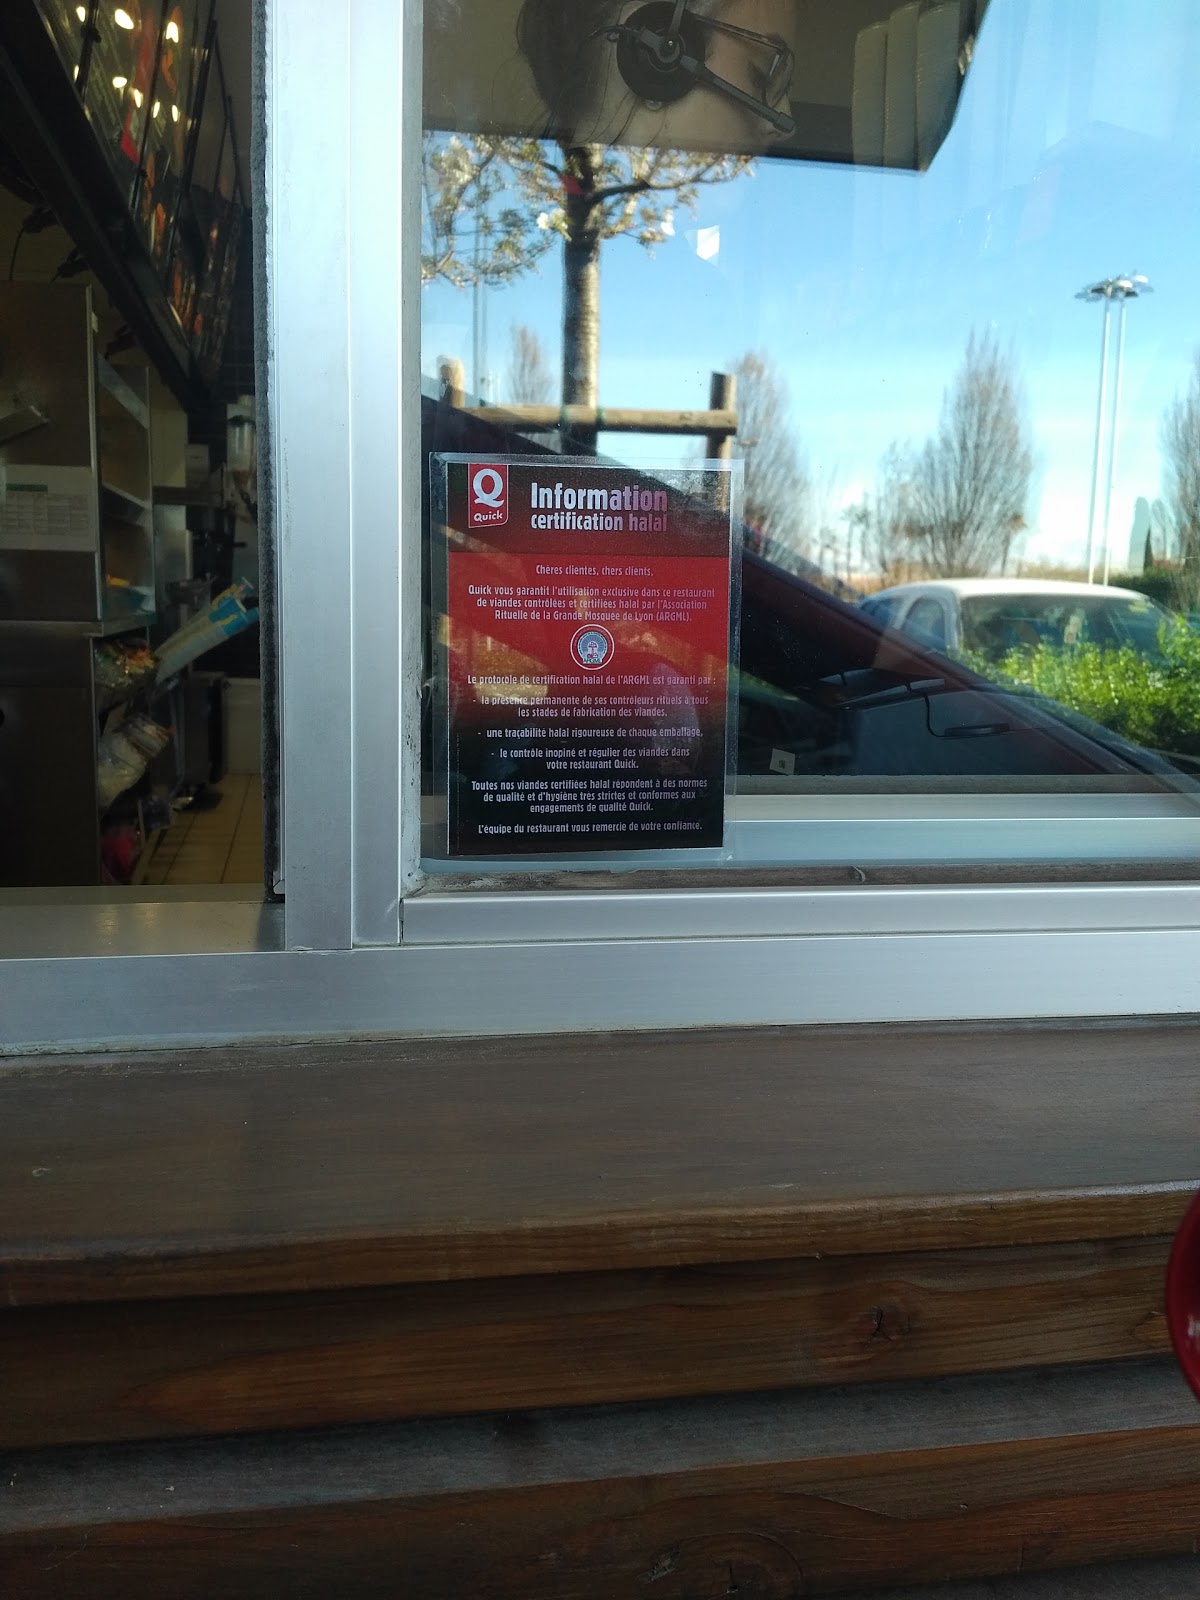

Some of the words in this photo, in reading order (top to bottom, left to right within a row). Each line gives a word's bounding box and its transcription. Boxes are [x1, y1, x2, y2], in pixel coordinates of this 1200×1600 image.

[532, 482, 668, 512] Information
[474, 510, 503, 522] Quick
[532, 512, 623, 530] certification
[629, 513, 667, 532] halal
[602, 566, 622, 576] chers
[468, 584, 492, 595] Quick
[494, 586, 514, 596] vous
[516, 586, 549, 596] garantit
[602, 587, 638, 596] exclusive
[642, 588, 660, 597] dans
[674, 588, 715, 598] restaurant
[477, 598, 486, 606] de
[490, 598, 521, 607] viandes
[569, 599, 577, 608] et
[619, 600, 639, 608] halal
[642, 601, 654, 610] par
[495, 610, 528, 620] Rituelle
[530, 610, 540, 620] de
[544, 610, 550, 620] la
[554, 611, 582, 620] Grande
[623, 612, 632, 620] de
[635, 612, 654, 621] Lyon
[468, 675, 476, 684] Le
[480, 675, 517, 684] protocole
[520, 675, 529, 684] de
[532, 675, 579, 684] certification
[582, 675, 603, 684] halal
[606, 675, 615, 684] de
[652, 676, 664, 684] est
[668, 676, 695, 685] garanti
[698, 677, 710, 685] par
[482, 696, 490, 704] la
[530, 696, 579, 705] permanente
[582, 696, 592, 704] de
[656, 696, 682, 704] rituels
[692, 696, 708, 704] tous
[518, 708, 530, 716] les
[532, 708, 558, 716] stades
[561, 708, 570, 716] de
[574, 707, 616, 716] fabrication
[618, 707, 632, 716] des
[486, 730, 502, 738] une
[548, 728, 569, 738] halal
[572, 728, 614, 738] rigoureuse
[616, 728, 626, 736] de
[628, 728, 656, 738] chaque
[500, 748, 508, 758] le
[578, 748, 586, 757] et
[622, 748, 636, 756] des
[638, 748, 668, 756] viandes
[671, 748, 690, 756] dans
[546, 760, 568, 769] votre
[570, 760, 612, 769] restaurant
[472, 780, 498, 790] Toutes
[500, 782, 514, 790] nos
[517, 780, 548, 790] viandes
[590, 780, 610, 788] halal
[662, 779, 676, 788] des
[678, 780, 708, 788] normes
[484, 792, 494, 802] de
[528, 792, 536, 801] et
[597, 791, 626, 800] strictes
[628, 792, 636, 800] et
[638, 790, 678, 800] conformes
[530, 804, 584, 814] engagements
[586, 803, 596, 812] de
[514, 824, 524, 833] du
[527, 824, 569, 832] restaurant
[572, 824, 590, 832] vous
[592, 822, 626, 832] remercie
[628, 822, 638, 830] de
[640, 822, 661, 830] votre
